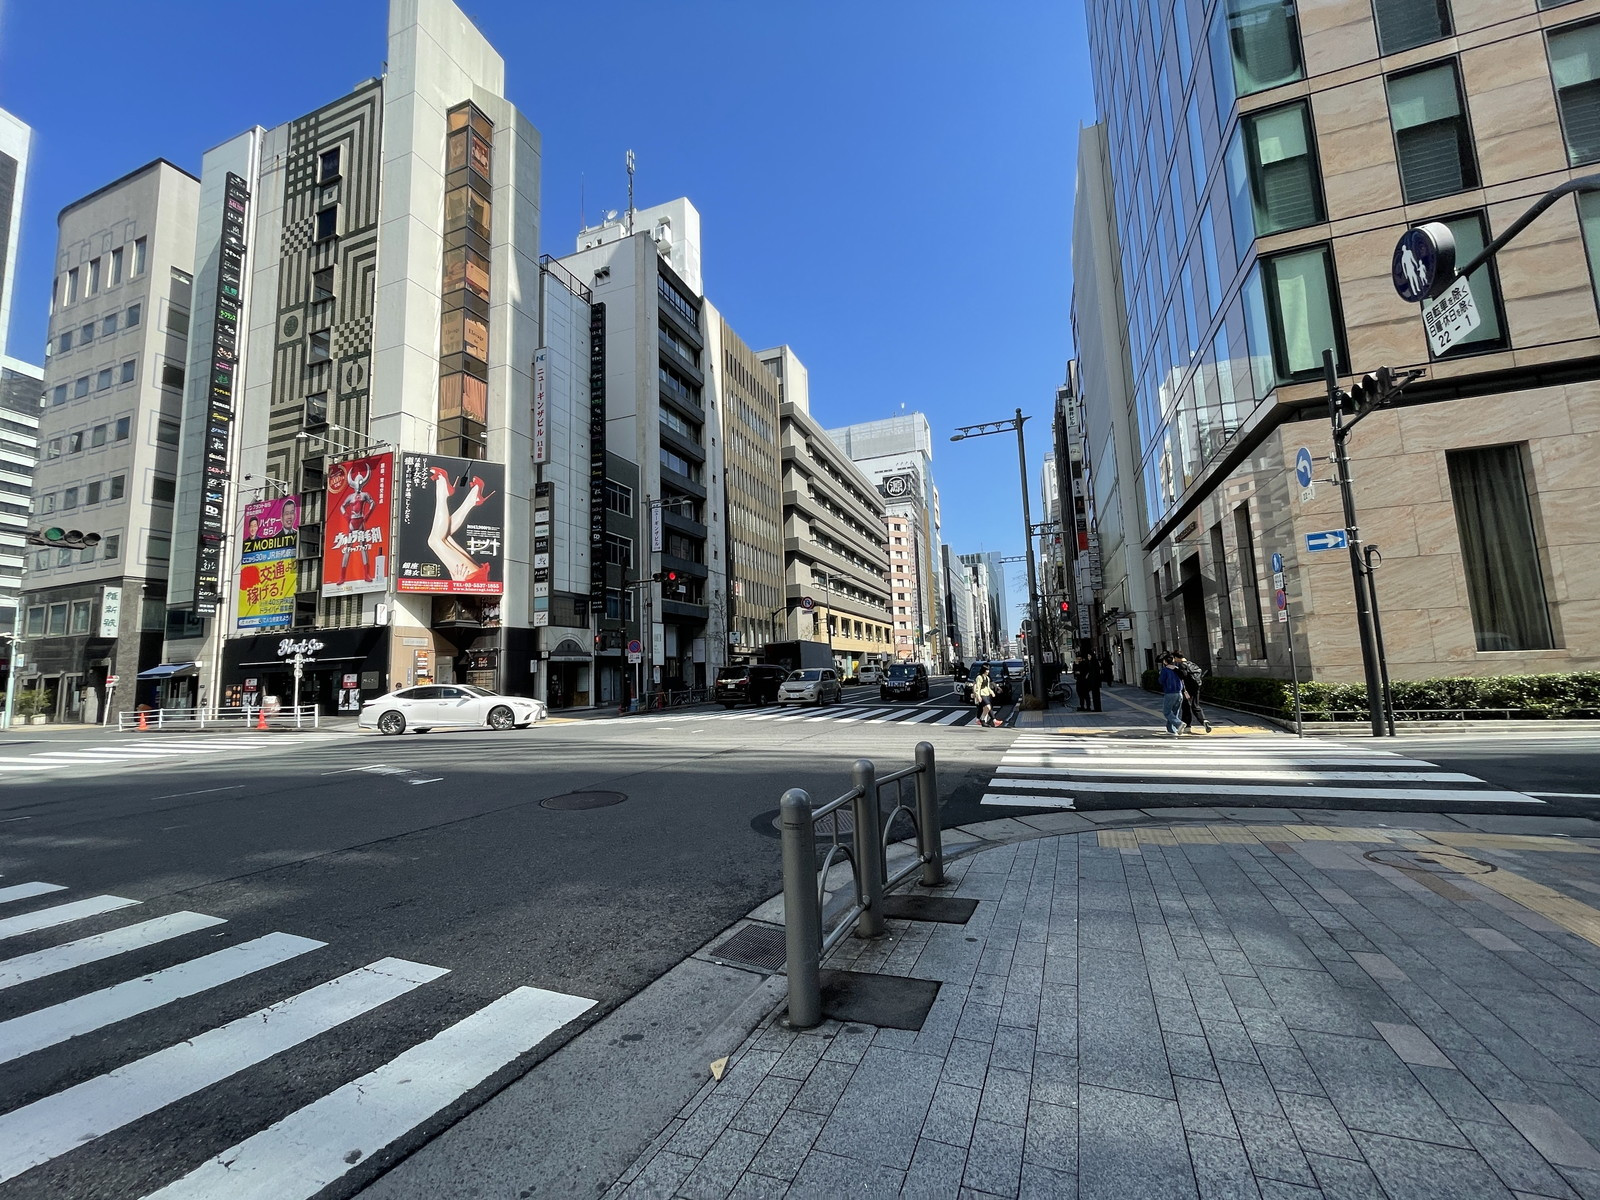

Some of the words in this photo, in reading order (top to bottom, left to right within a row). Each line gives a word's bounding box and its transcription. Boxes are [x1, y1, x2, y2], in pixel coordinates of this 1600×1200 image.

[1425, 285, 1468, 324] 自転車を除く
[259, 517, 282, 528] ハイヤー
[243, 541, 252, 553] Z
[253, 534, 297, 551] MOBILITY
[331, 526, 383, 550] ウルトラ育毛剤
[535, 541, 547, 549] BAR
[259, 559, 298, 585] 交通より
